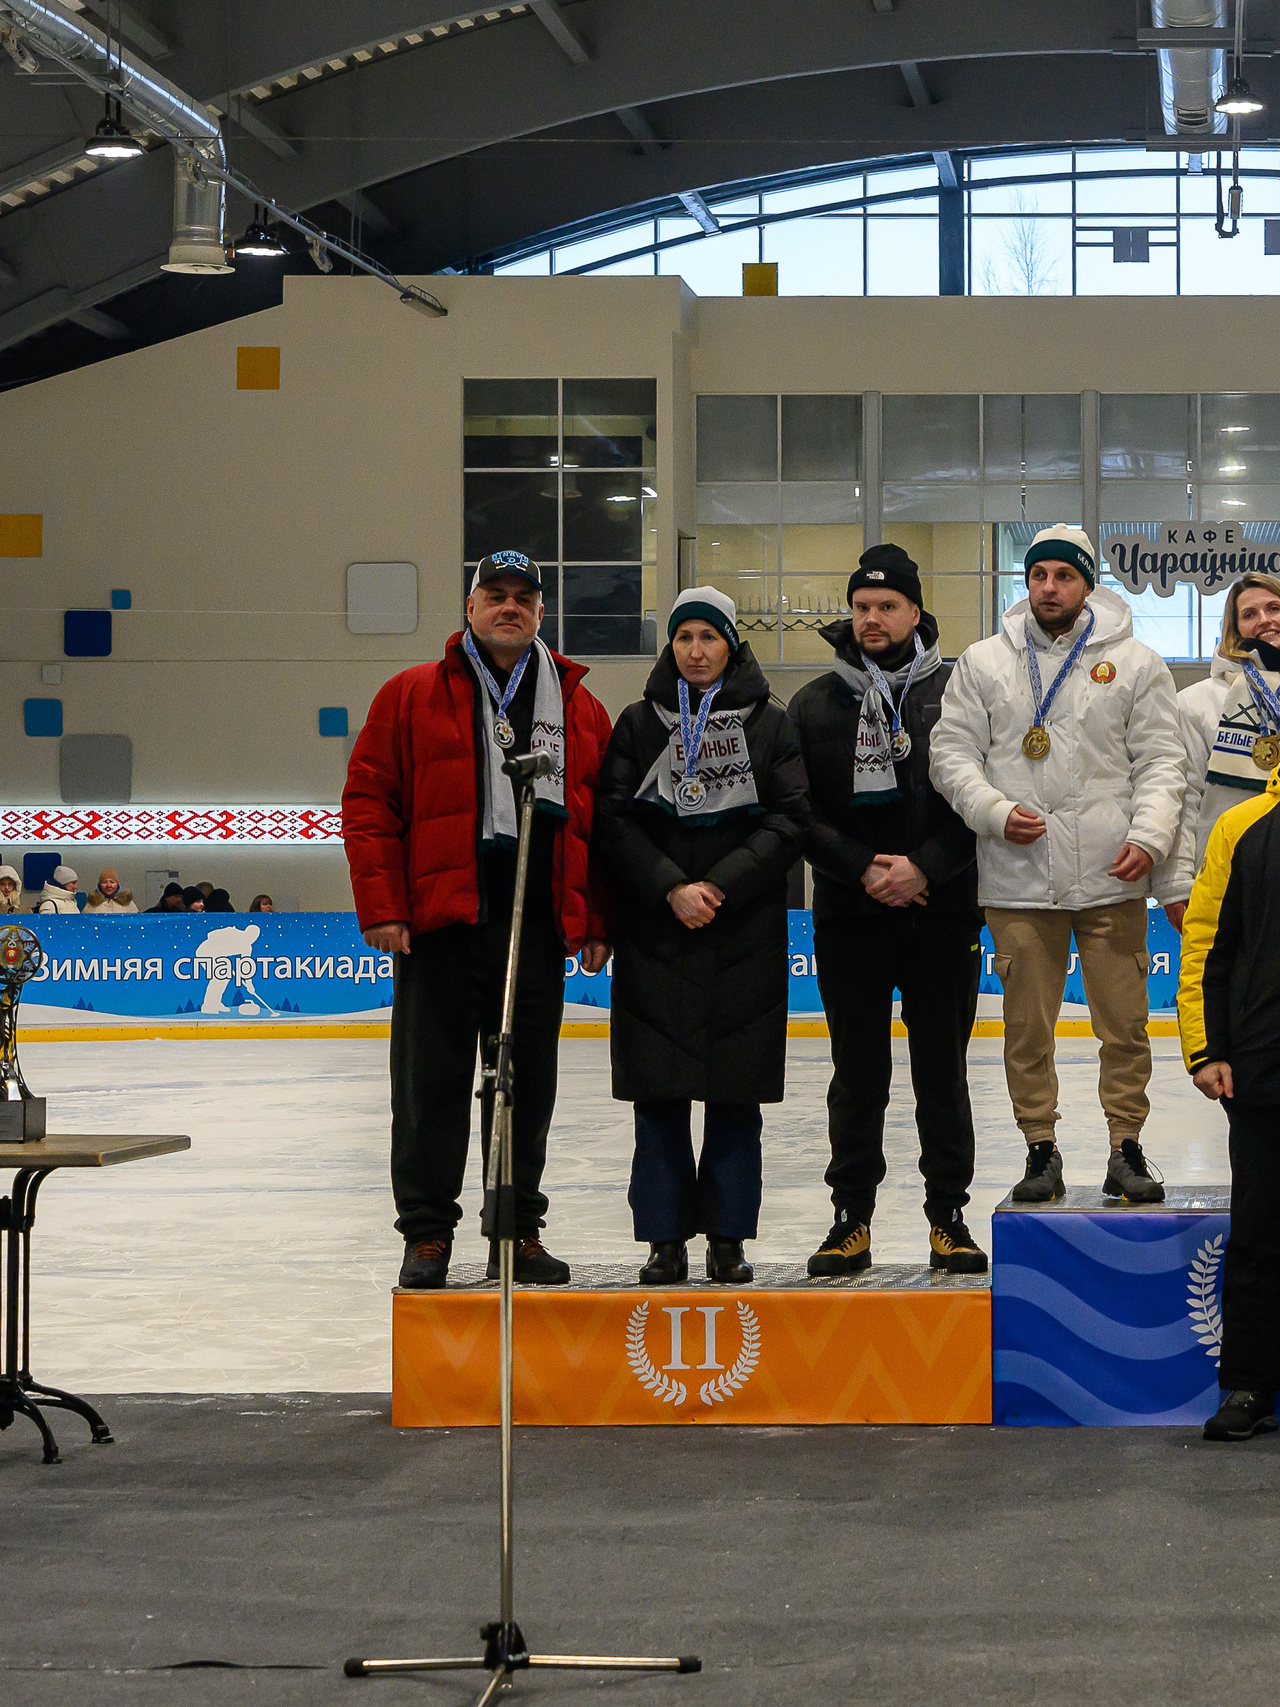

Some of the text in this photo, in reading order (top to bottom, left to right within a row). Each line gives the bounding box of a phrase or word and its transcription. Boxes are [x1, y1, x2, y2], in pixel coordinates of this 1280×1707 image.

[1168, 529, 1234, 544] КАФЕ
[675, 737, 741, 761] ЕИНЫЕ
[1217, 730, 1253, 748] БЕЛЫЕ
[31, 951, 394, 987] Зимняя спартакиада
